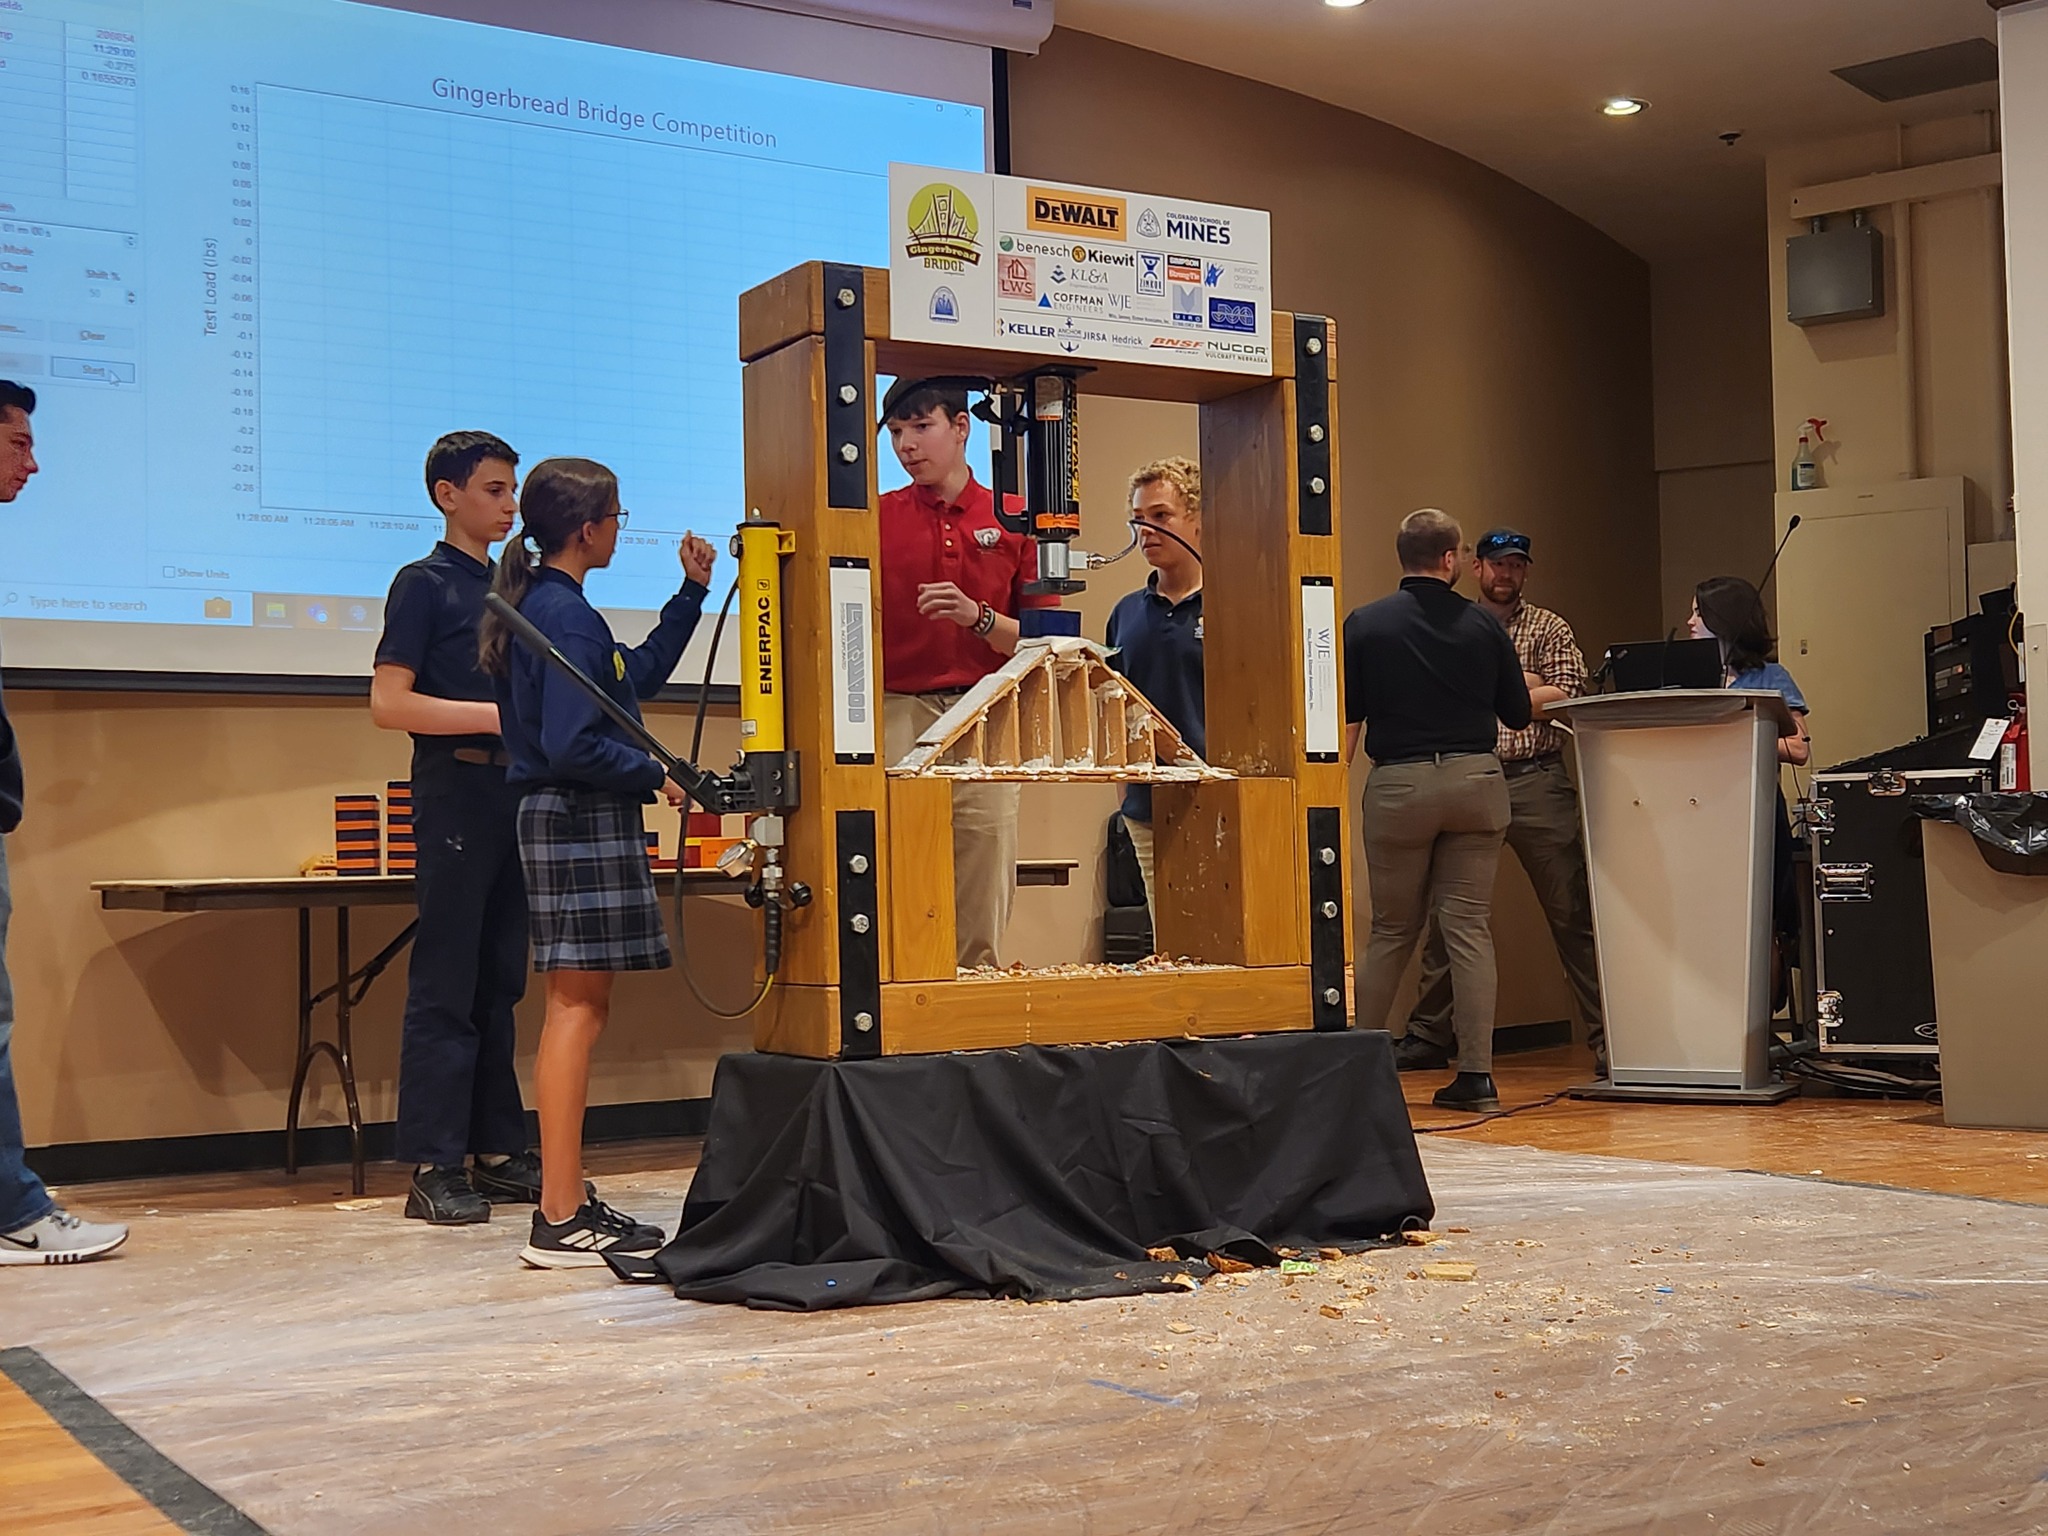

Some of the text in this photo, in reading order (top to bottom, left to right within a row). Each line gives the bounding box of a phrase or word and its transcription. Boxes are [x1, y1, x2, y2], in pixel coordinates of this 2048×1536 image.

[433, 78, 777, 148] Gingerbread Bridge Competition
[1166, 212, 1198, 221] COLORADO
[1199, 217, 1222, 225] SCHOOL
[1167, 219, 1230, 245] MINES
[909, 246, 976, 262] Gingerbread
[1017, 239, 1070, 257] benesch
[924, 258, 965, 272] BRIDGE
[1088, 249, 1135, 267] Kiewit
[203, 238, 219, 336] Test Load (lbs)
[1001, 279, 1033, 294] LWS
[1053, 292, 1103, 306] COFFMAN
[1108, 293, 1132, 311] WJE
[1053, 303, 1103, 314] ENGINEERS
[1008, 323, 1055, 338] KELLER
[1083, 332, 1107, 342] JIRSA
[1112, 334, 1143, 345] Hedrick
[1152, 337, 1204, 348] BNSF
[1208, 341, 1266, 355] NUCOR
[1206, 353, 1268, 363] VULCRAFT NEBRASKA
[274, 515, 289, 523] AM
[340, 519, 354, 527] AM
[406, 523, 419, 531] AM
[177, 568, 230, 579] Show Units
[29, 595, 147, 612] Type here to search
[757, 596, 773, 695] ENERPAC
[1315, 628, 1331, 659] WJE
